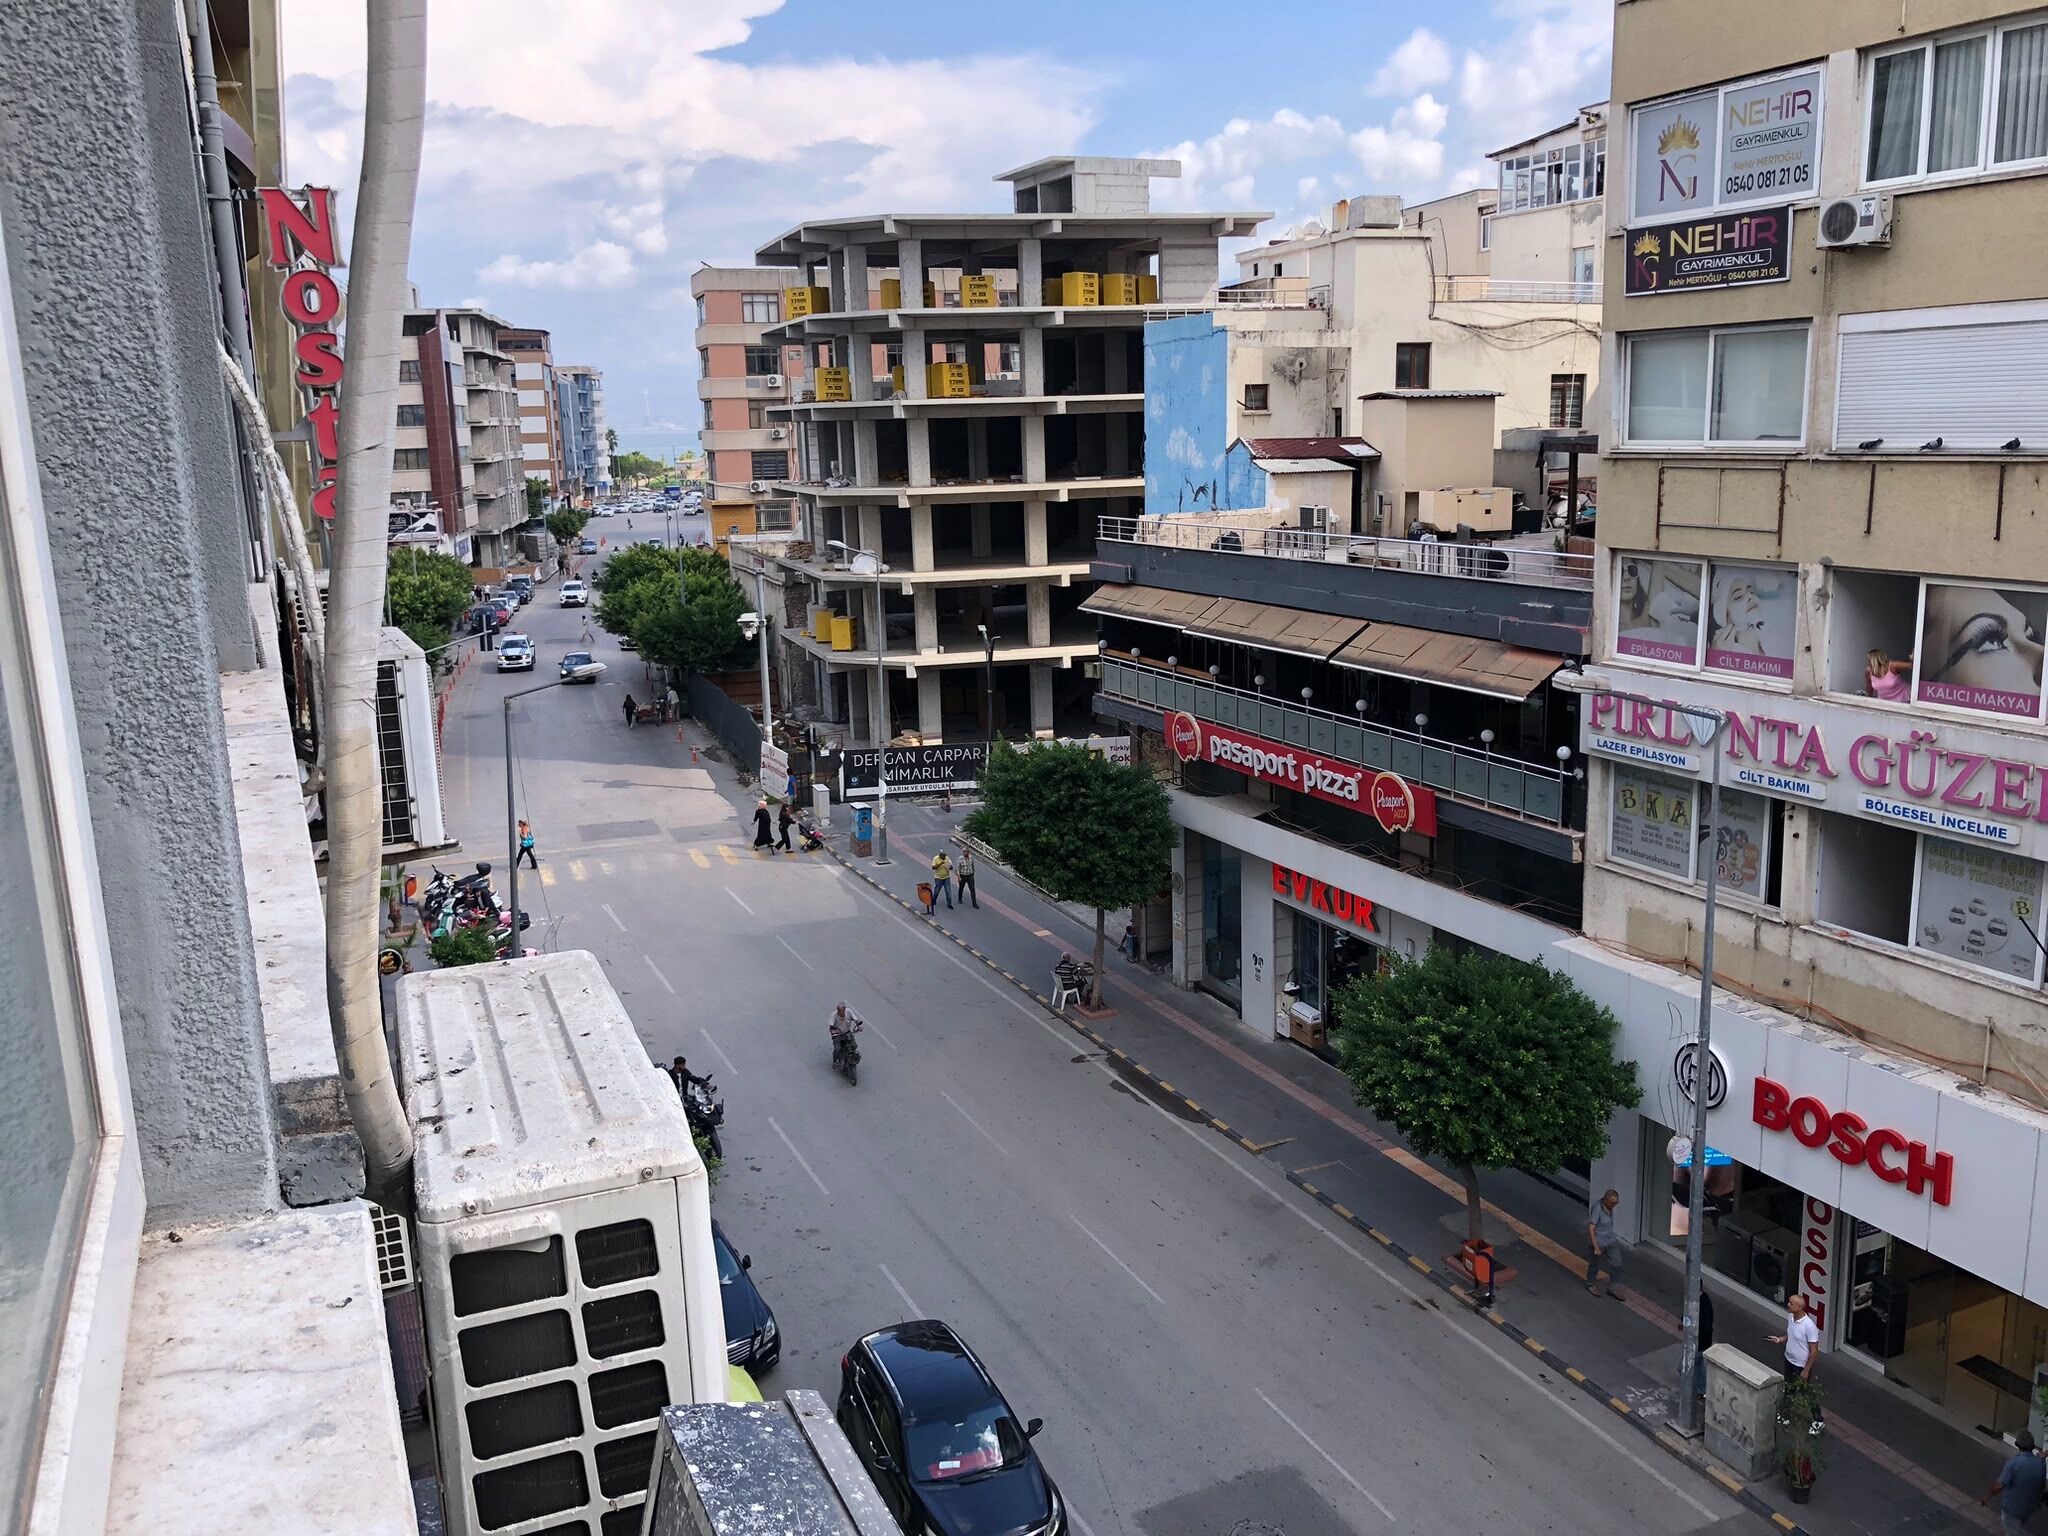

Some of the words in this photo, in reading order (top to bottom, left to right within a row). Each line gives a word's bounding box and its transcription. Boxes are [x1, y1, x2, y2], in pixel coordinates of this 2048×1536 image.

[1729, 89, 1812, 130] NEHİR
[1735, 126, 1803, 148] GAYRİMENKUL
[1756, 150, 1802, 168] MERTOĞLU
[1726, 174, 1754, 195] 0540
[1757, 169, 1776, 190] 081
[1778, 166, 1791, 186] 21
[1793, 163, 1809, 183] 05
[1670, 216, 1778, 257] NEHİR
[1681, 252, 1764, 272] GAYRİMENKUL
[1668, 278, 1686, 287] Nehir
[1686, 272, 1722, 286] MERTOĞLU
[1728, 271, 1746, 281] 0540
[1746, 269, 1760, 279] 081
[1760, 268, 1768, 277] 21
[1769, 267, 1779, 276] 05
[1630, 642, 1683, 663] EPİLASYON
[1719, 654, 1741, 672] CİLT
[1743, 658, 1783, 676] BAKIMI
[1926, 685, 1971, 705] KALICI
[1974, 690, 2032, 714] MAKYAJ
[1597, 738, 1627, 754] LAZER
[1629, 743, 1686, 767] EPİLASYON
[1210, 735, 1298, 782] pasaport
[1303, 759, 1359, 802] pizza
[1739, 770, 1765, 785] CİLT
[1767, 776, 1811, 795] BAKIMI
[1865, 798, 1936, 825] BÖLGESEL
[1941, 812, 2008, 840] İNCELME
[1272, 862, 1376, 933] EVKUR
[1752, 1076, 1953, 1207] BOSCH
